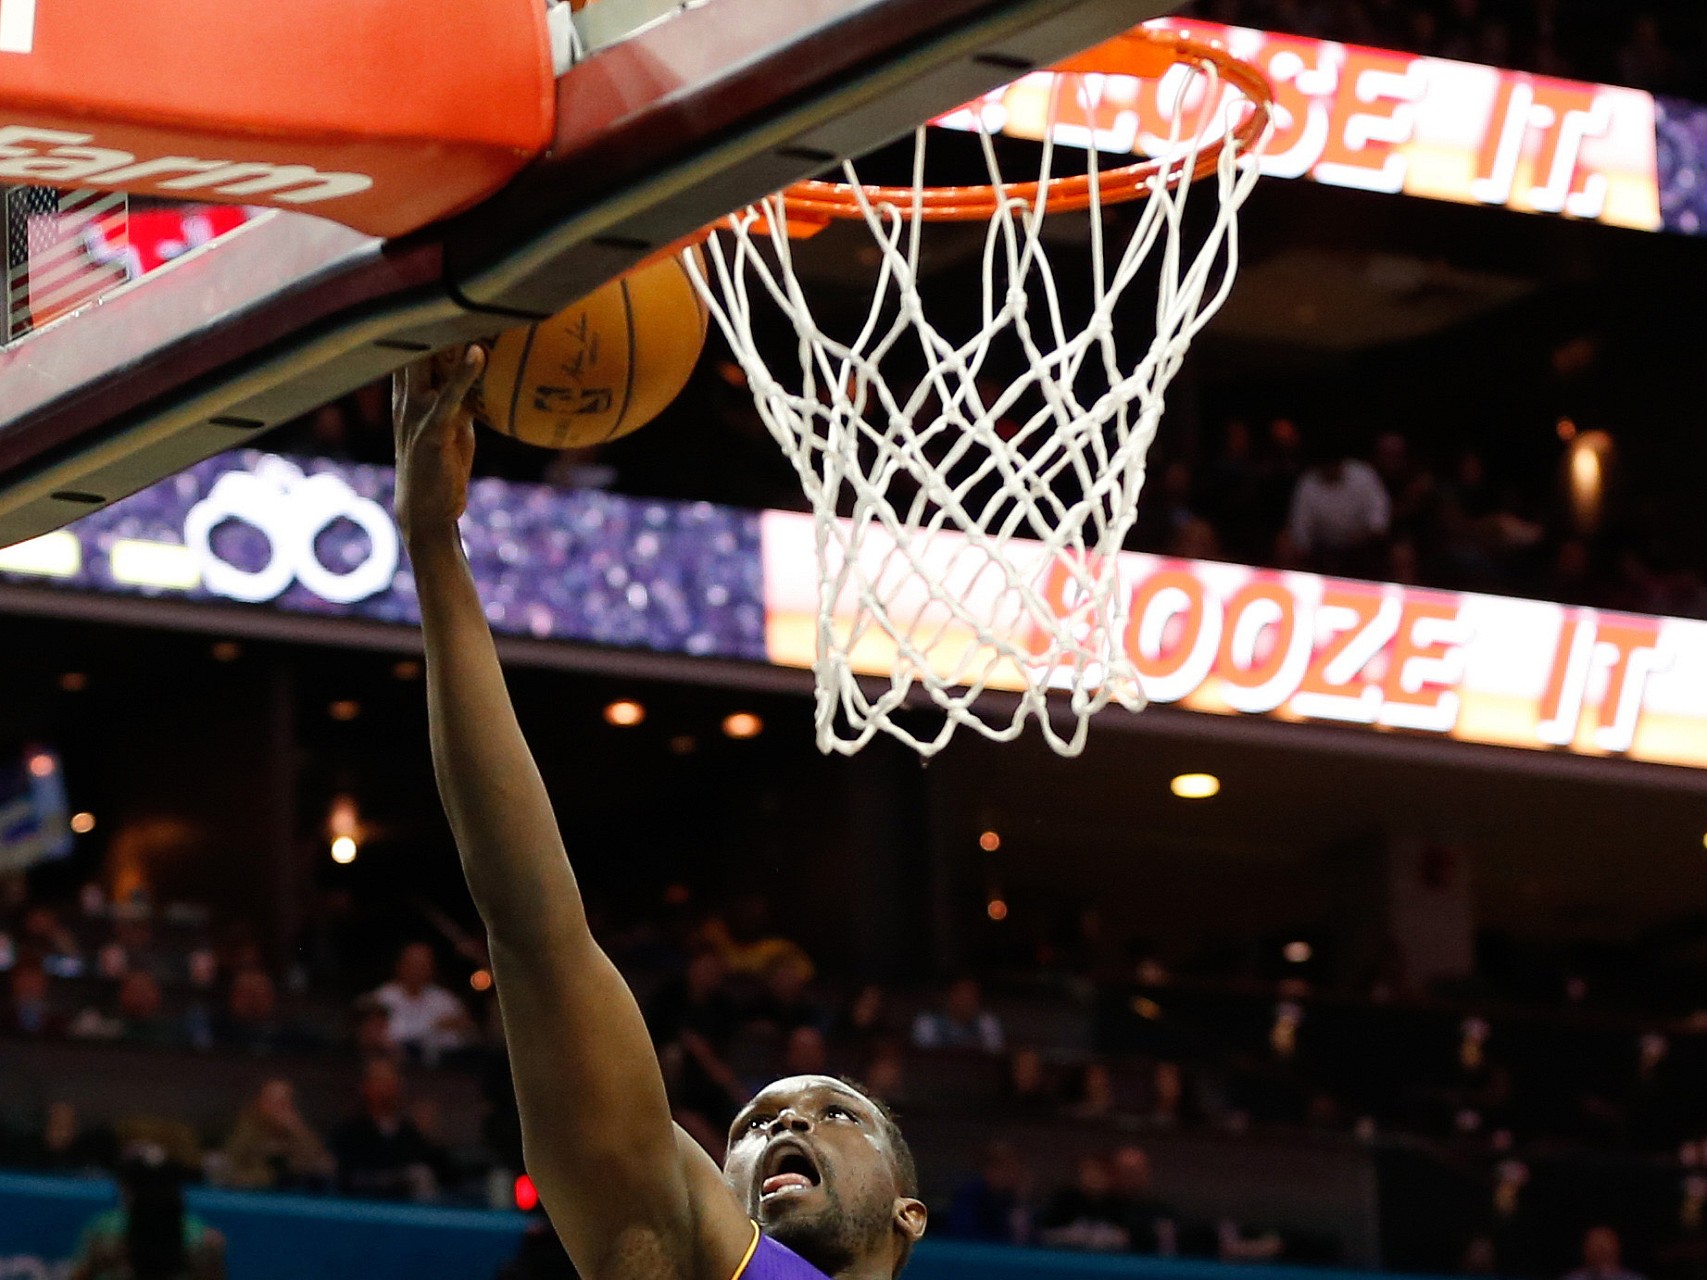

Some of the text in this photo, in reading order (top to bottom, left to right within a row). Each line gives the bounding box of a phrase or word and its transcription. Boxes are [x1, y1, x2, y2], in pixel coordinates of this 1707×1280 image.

[0, 125, 374, 204] Farm
[1474, 70, 1610, 218] IT
[1538, 606, 1664, 750] IT
